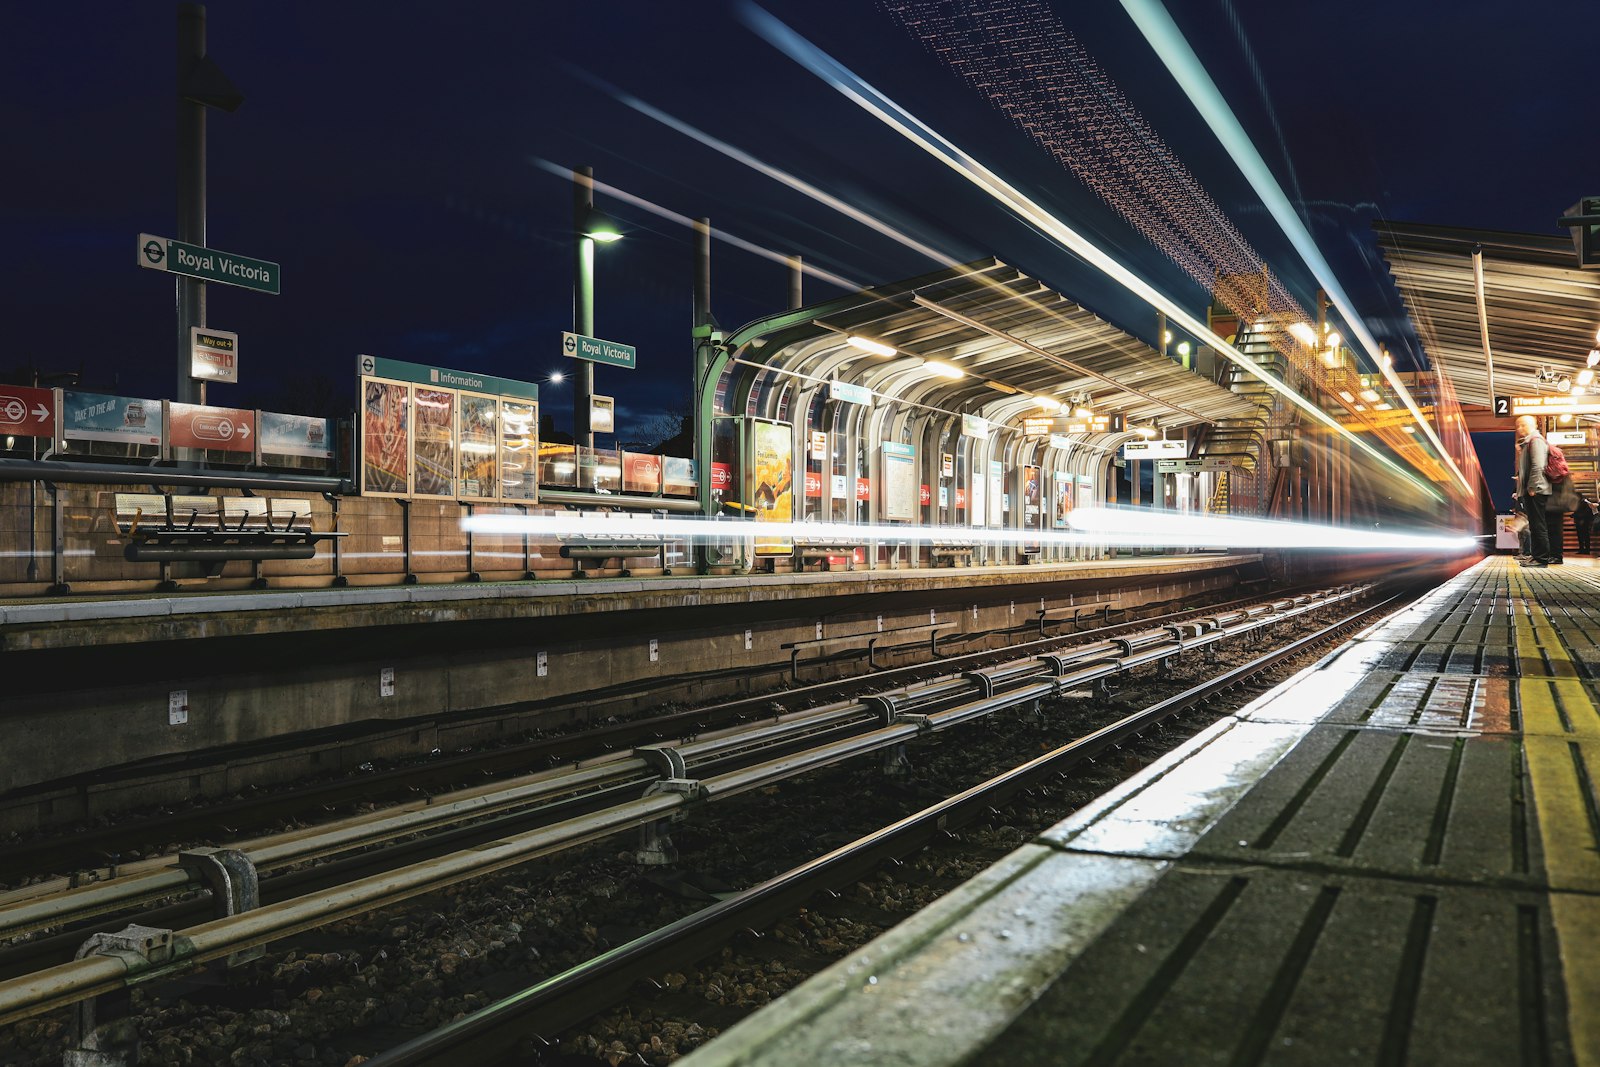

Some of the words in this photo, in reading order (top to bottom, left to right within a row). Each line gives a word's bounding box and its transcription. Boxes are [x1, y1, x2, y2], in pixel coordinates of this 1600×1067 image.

[178, 248, 214, 271] Royal
[218, 257, 270, 282] Victoria
[203, 336, 215, 346] Way
[582, 340, 602, 356] Royal
[603, 344, 630, 361] Victoria
[440, 372, 483, 388] Information
[74, 409, 87, 422] TAKE
[88, 406, 96, 418] TO
[96, 403, 106, 414] THE
[106, 400, 116, 412] AIR
[1498, 399, 1508, 413] 2
[1114, 416, 1119, 429] 1
